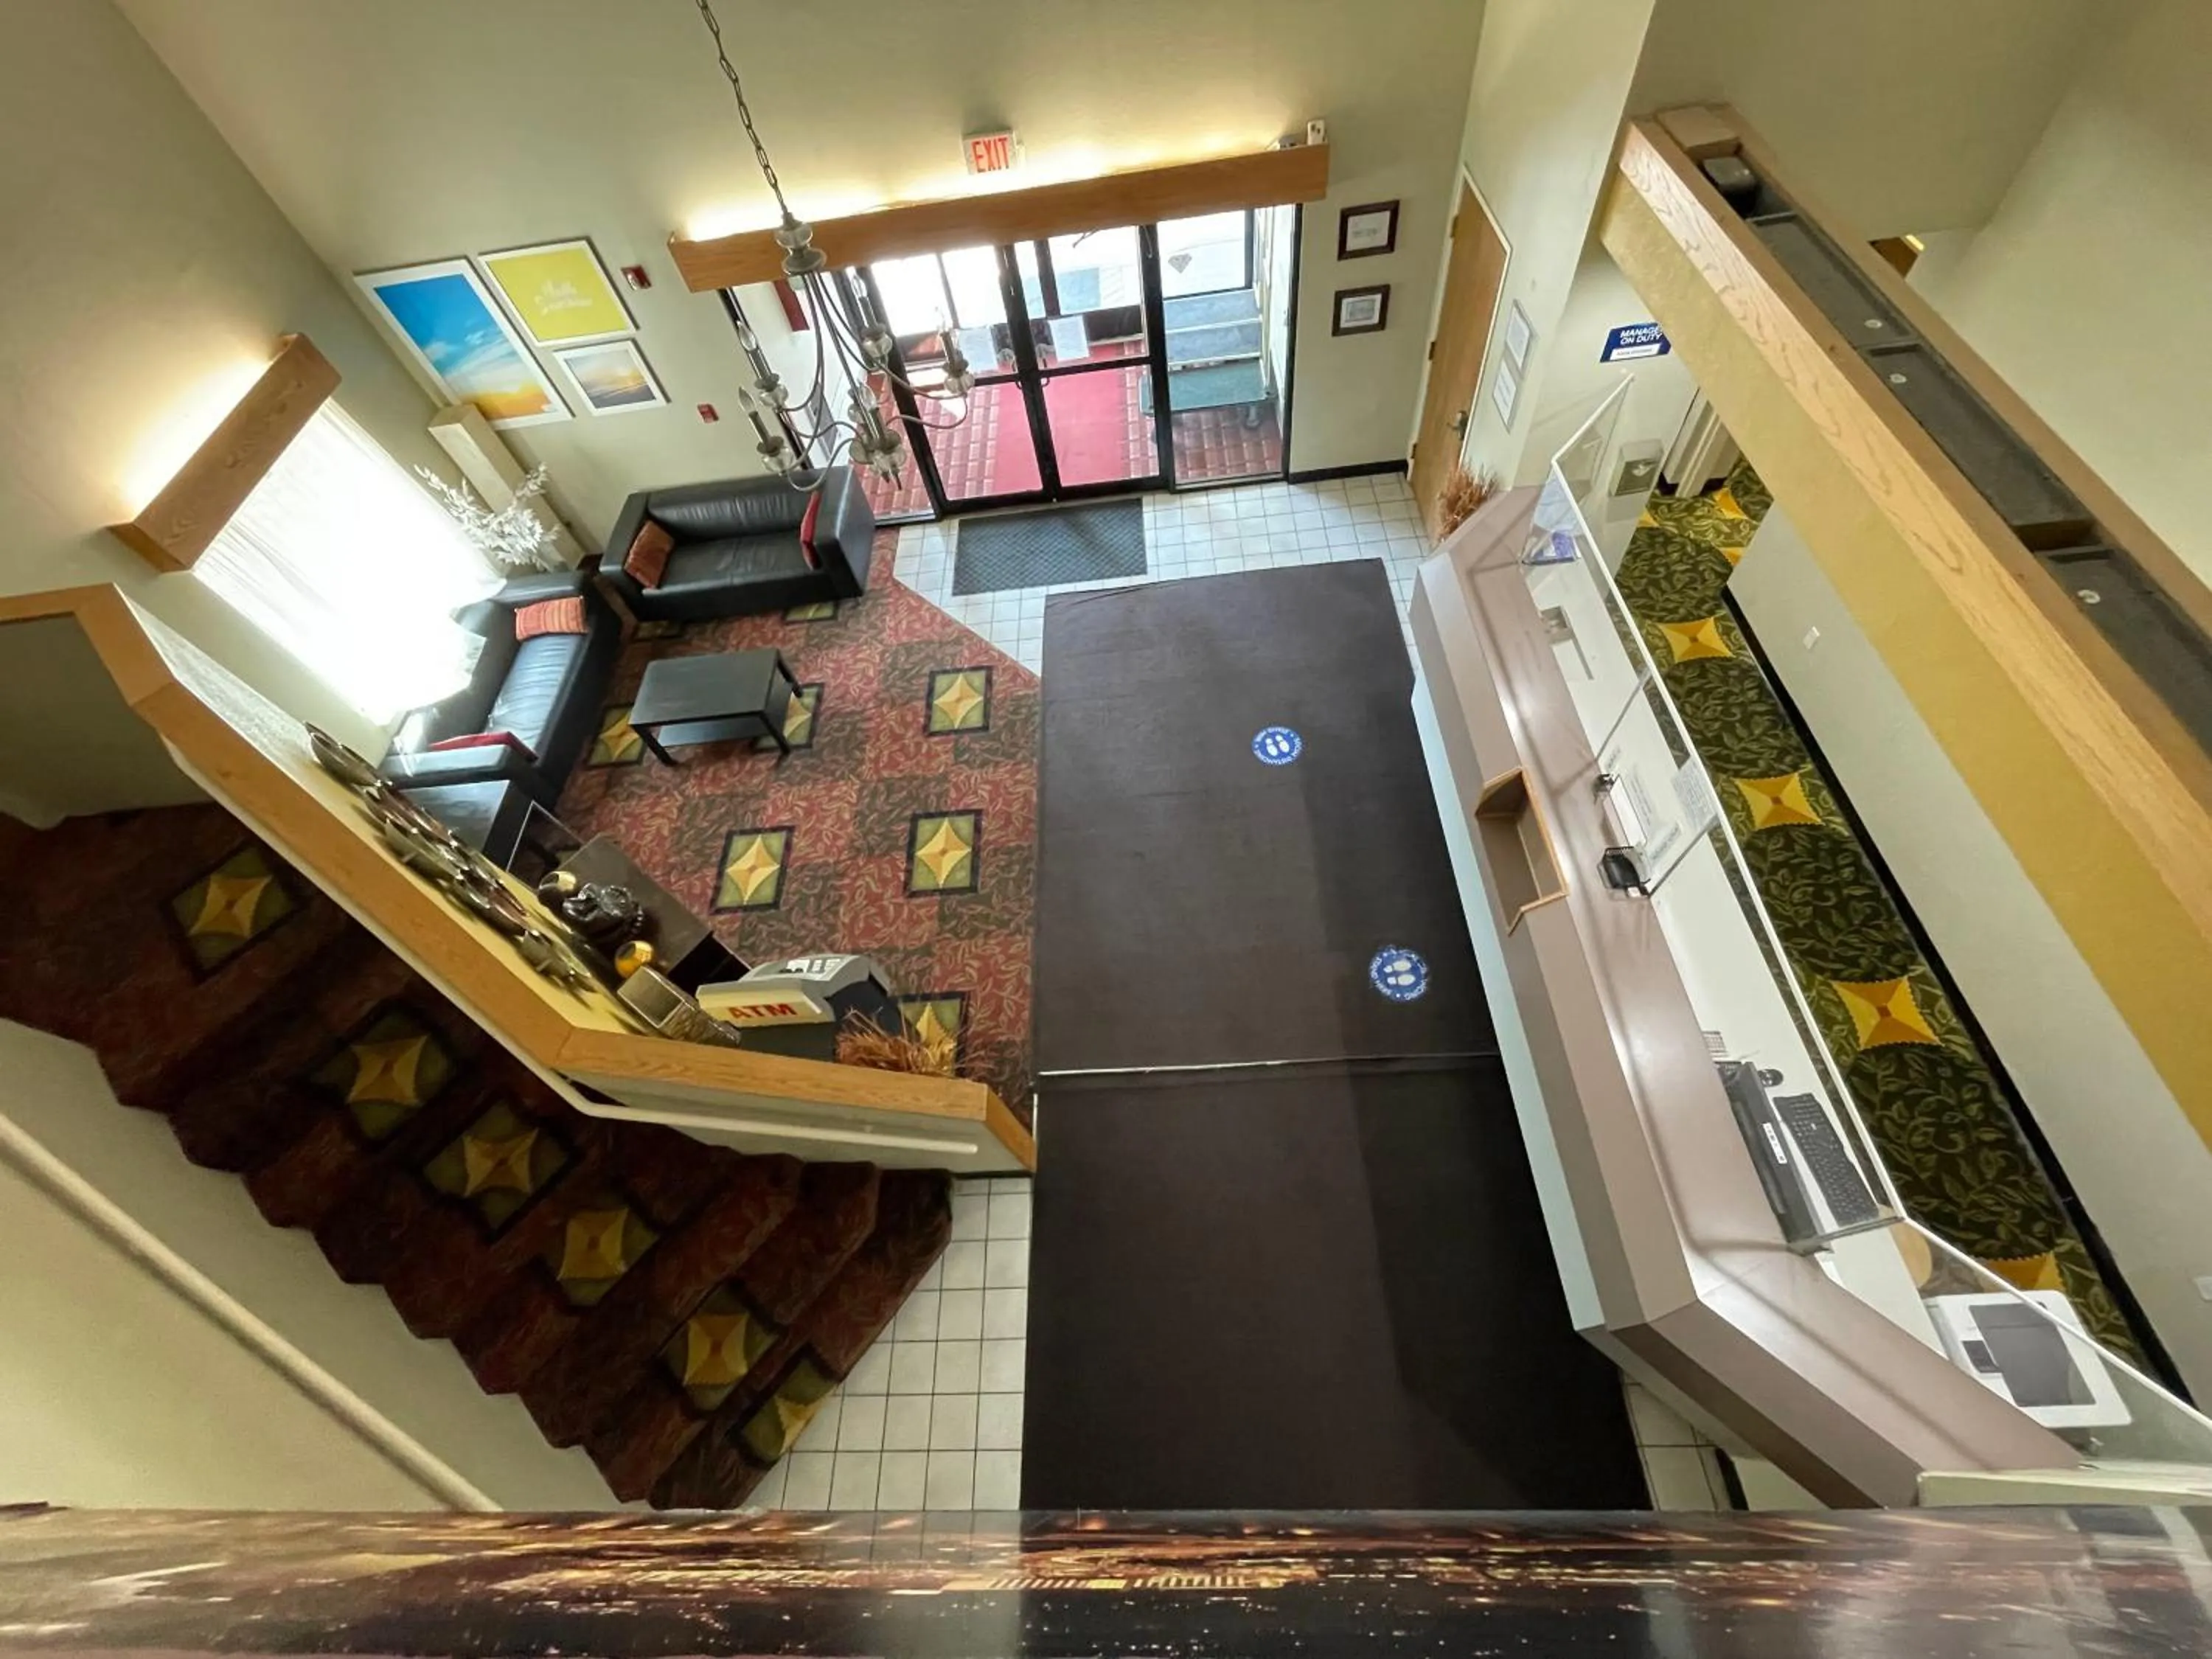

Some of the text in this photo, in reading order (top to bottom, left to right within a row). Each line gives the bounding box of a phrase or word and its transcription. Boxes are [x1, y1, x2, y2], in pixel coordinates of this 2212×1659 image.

[971, 137, 1009, 173] EXIT
[1620, 333, 1663, 345] ON DUTY
[728, 1003, 797, 1020] ATM
